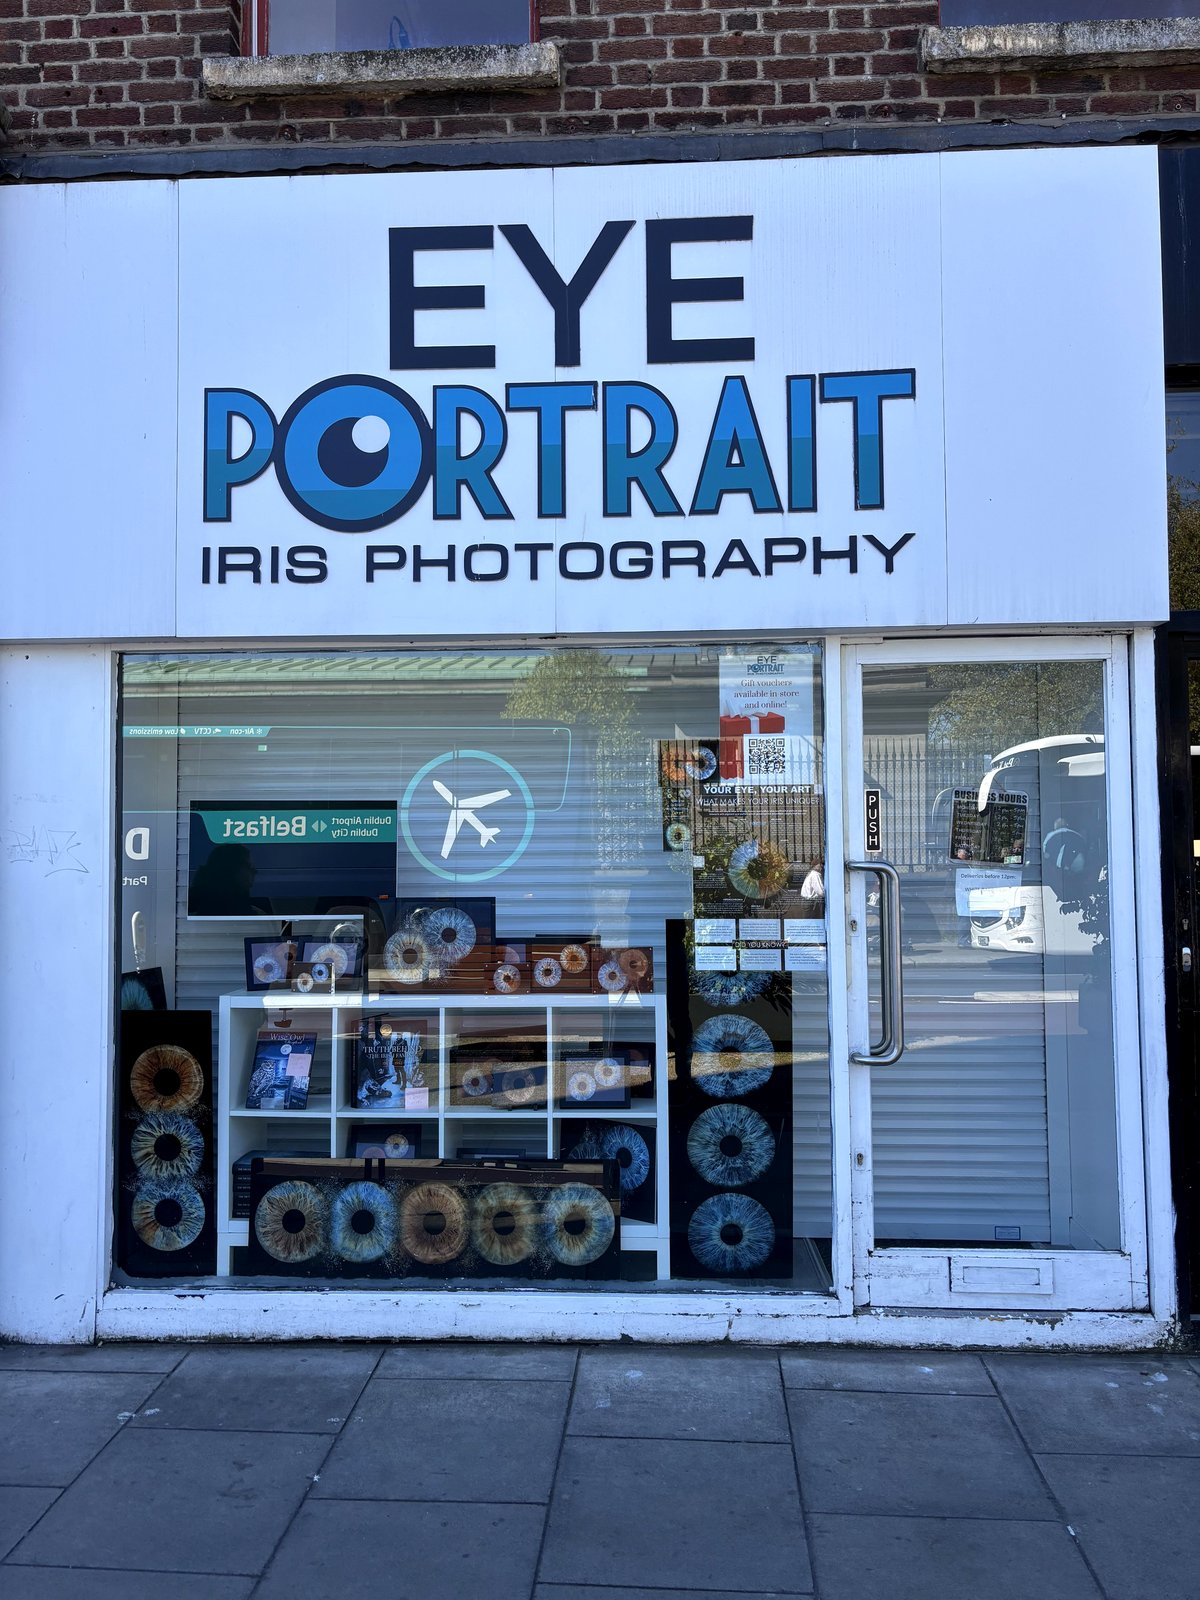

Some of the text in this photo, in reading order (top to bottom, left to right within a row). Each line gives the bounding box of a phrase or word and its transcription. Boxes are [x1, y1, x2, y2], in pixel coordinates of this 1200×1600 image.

[389, 215, 755, 370] EYE
[203, 368, 916, 532] PORTRAIT
[202, 533, 916, 584] IRIS PHOTOGRAPHY
[757, 656, 777, 664] EYE
[747, 664, 785, 673] PORTRAIT
[741, 679, 792, 687] Gift vouchers
[734, 690, 768, 698] available
[704, 786, 811, 794] YOUR EYE, YOUR ART
[954, 790, 1028, 804] BUSINSS HOURS
[696, 798, 718, 806] WHAT
[720, 798, 746, 806] MAKES
[868, 795, 878, 846] PUSH
[270, 1033, 305, 1041] Wise Owl
[363, 1045, 422, 1054] TRUTH BEHIND
